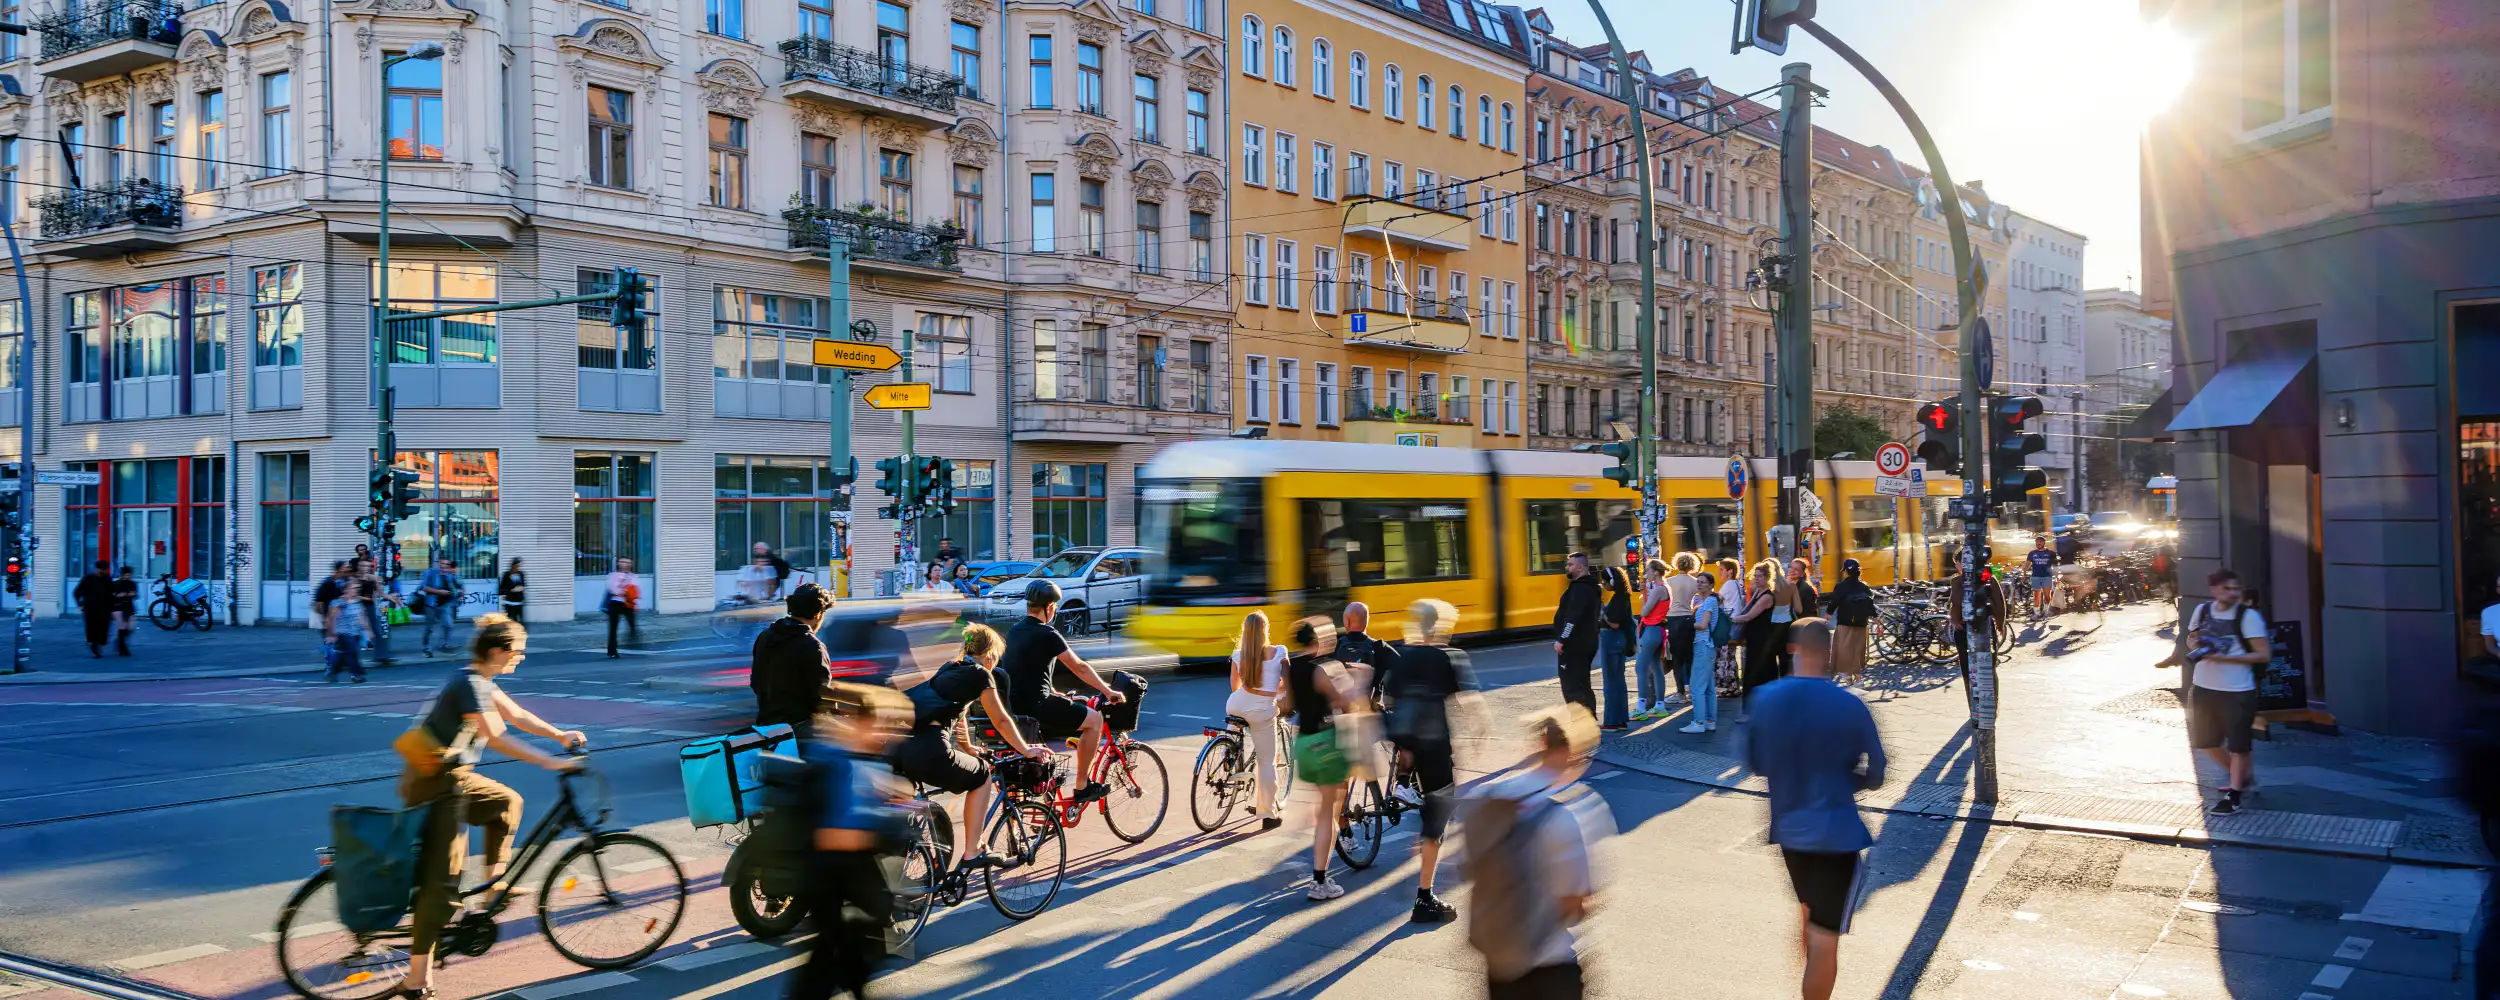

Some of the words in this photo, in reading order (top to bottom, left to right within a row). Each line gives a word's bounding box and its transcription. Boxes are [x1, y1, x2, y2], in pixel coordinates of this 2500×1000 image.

[833, 348, 876, 364] Wedding
[890, 392, 909, 401] Mitte
[1883, 452, 1902, 467] 30
